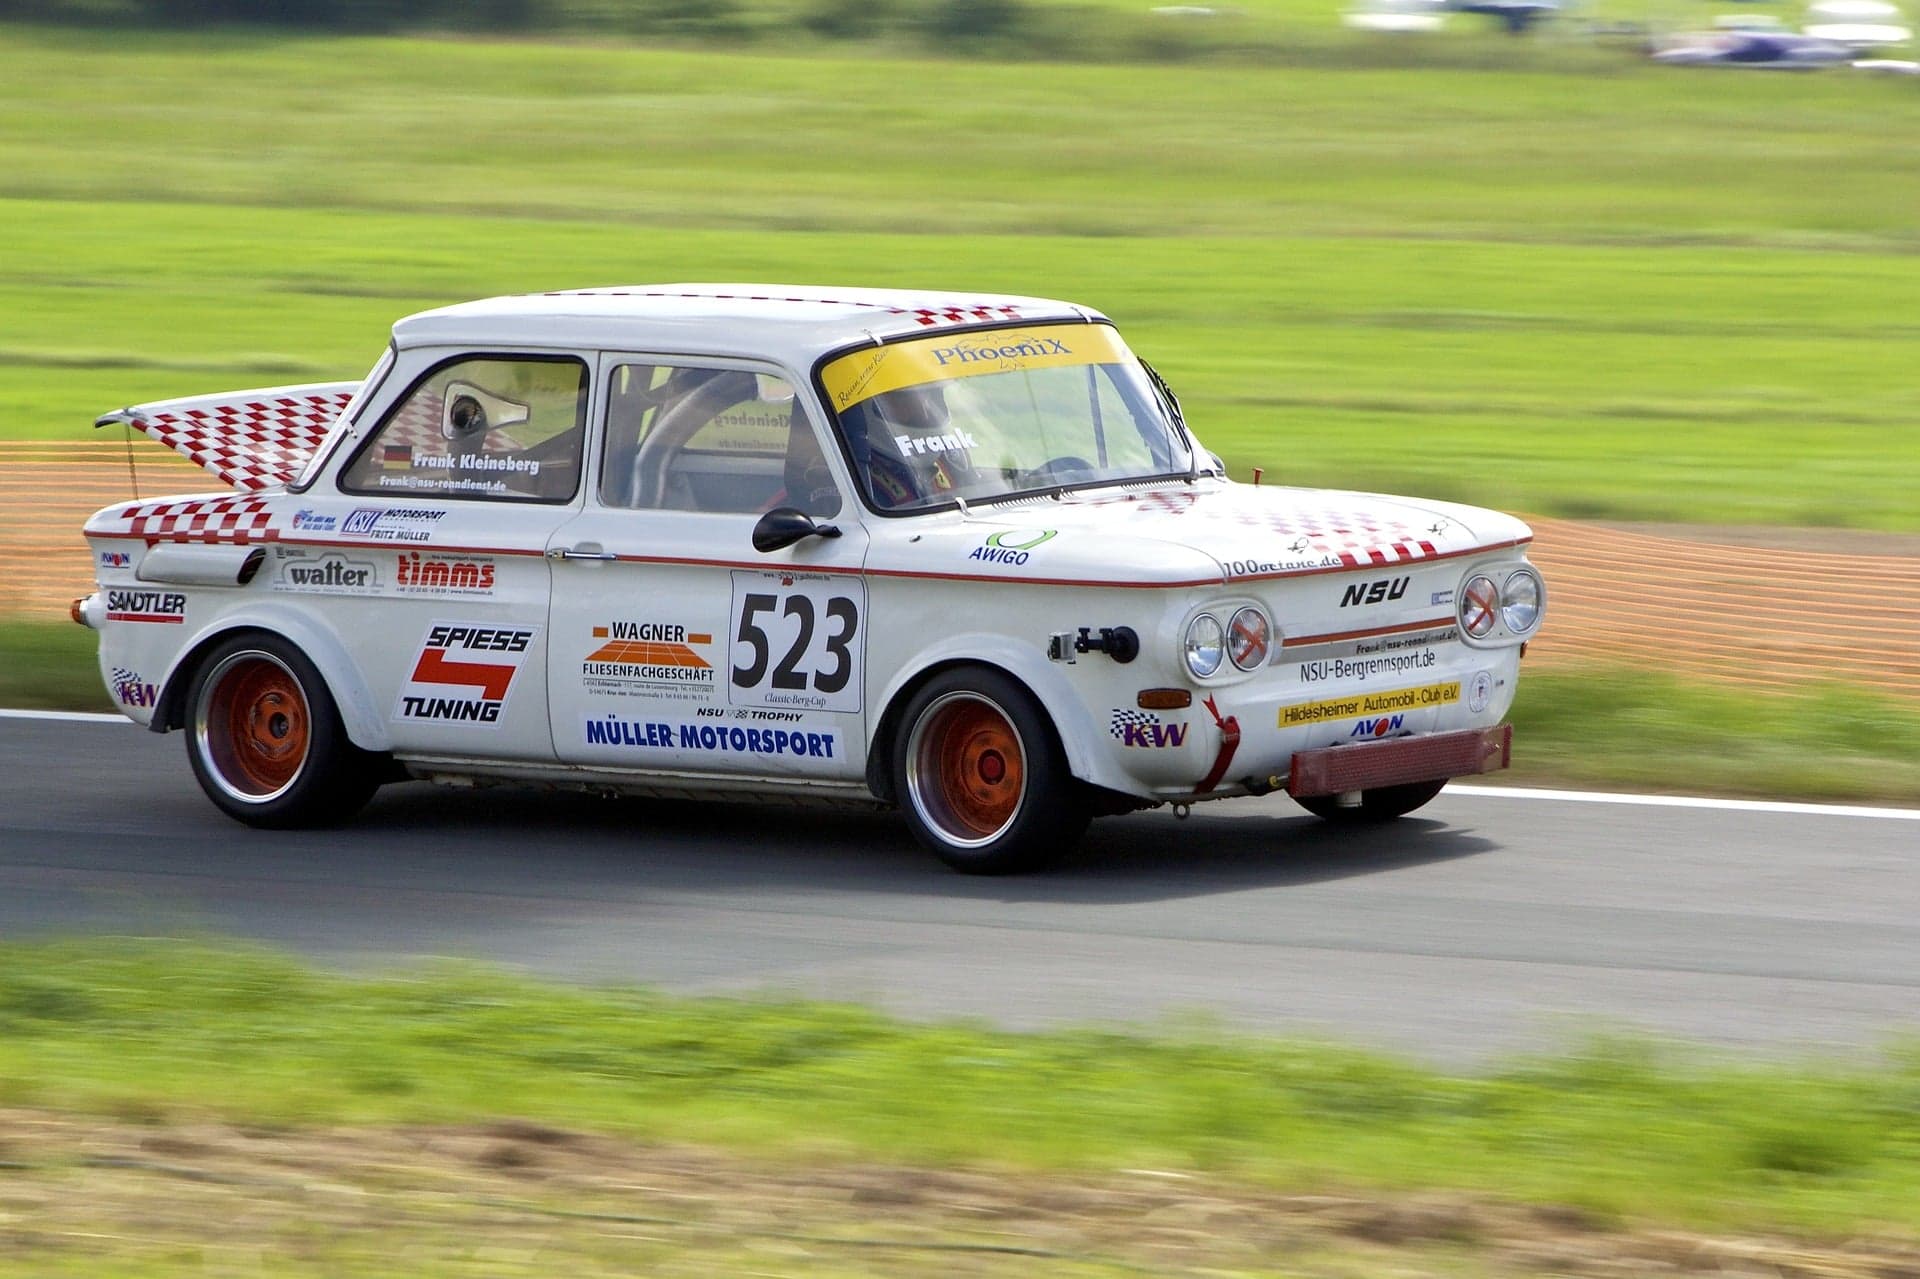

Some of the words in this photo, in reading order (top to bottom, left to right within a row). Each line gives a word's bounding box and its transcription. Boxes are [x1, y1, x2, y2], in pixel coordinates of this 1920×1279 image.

[895, 428, 978, 457] Frank
[413, 453, 456, 469] Frank
[459, 454, 540, 475] Kleineberg
[344, 510, 378, 533] NSU
[383, 508, 447, 521] MOTORSPORT
[370, 529, 395, 540] FRITZ
[396, 528, 431, 542] MÜLLER
[968, 546, 1029, 566] AWIGO
[291, 561, 369, 587] walter
[397, 551, 495, 589] timms
[107, 590, 186, 615] SANDTLER
[1340, 576, 1410, 608] NSU
[426, 626, 533, 652] SPIESS
[612, 621, 685, 642] WAGNER
[732, 593, 858, 693] 523
[583, 663, 715, 682] FLIESENFACHGESCHÄFT
[1301, 648, 1436, 683] NSU-Bergrennsport.de
[119, 681, 161, 707] KW
[1284, 702, 1359, 724] Hildesheimer
[1421, 687, 1441, 703] Club
[402, 696, 502, 722] TUNING
[696, 707, 724, 718] NSU
[750, 711, 804, 723] TROPHY
[586, 713, 675, 748] MÜLLER
[679, 724, 835, 759] MOTORSPORT
[1123, 722, 1189, 749] KW
